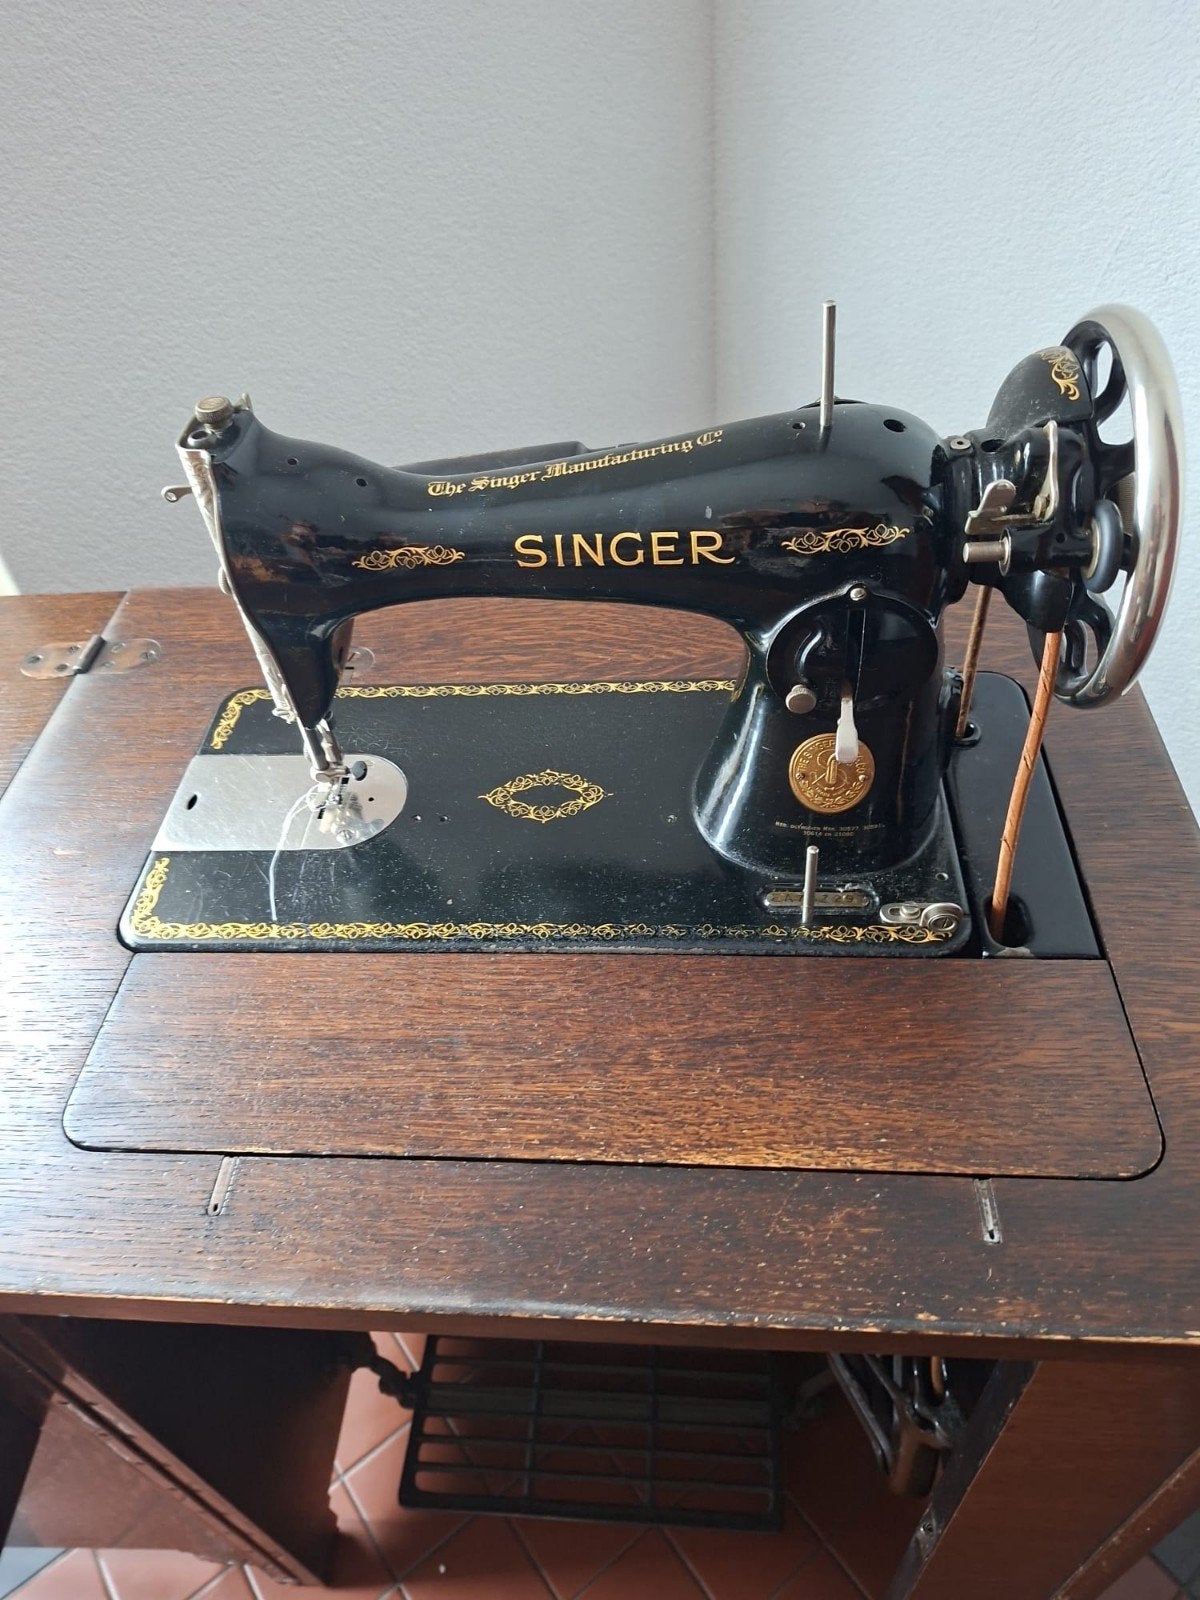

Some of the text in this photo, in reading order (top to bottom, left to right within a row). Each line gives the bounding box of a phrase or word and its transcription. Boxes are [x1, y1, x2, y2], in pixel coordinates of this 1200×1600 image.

[427, 480, 466, 498] The
[468, 470, 543, 492] Singer
[540, 438, 693, 482] Manufacturing
[514, 531, 736, 569] SINGER
